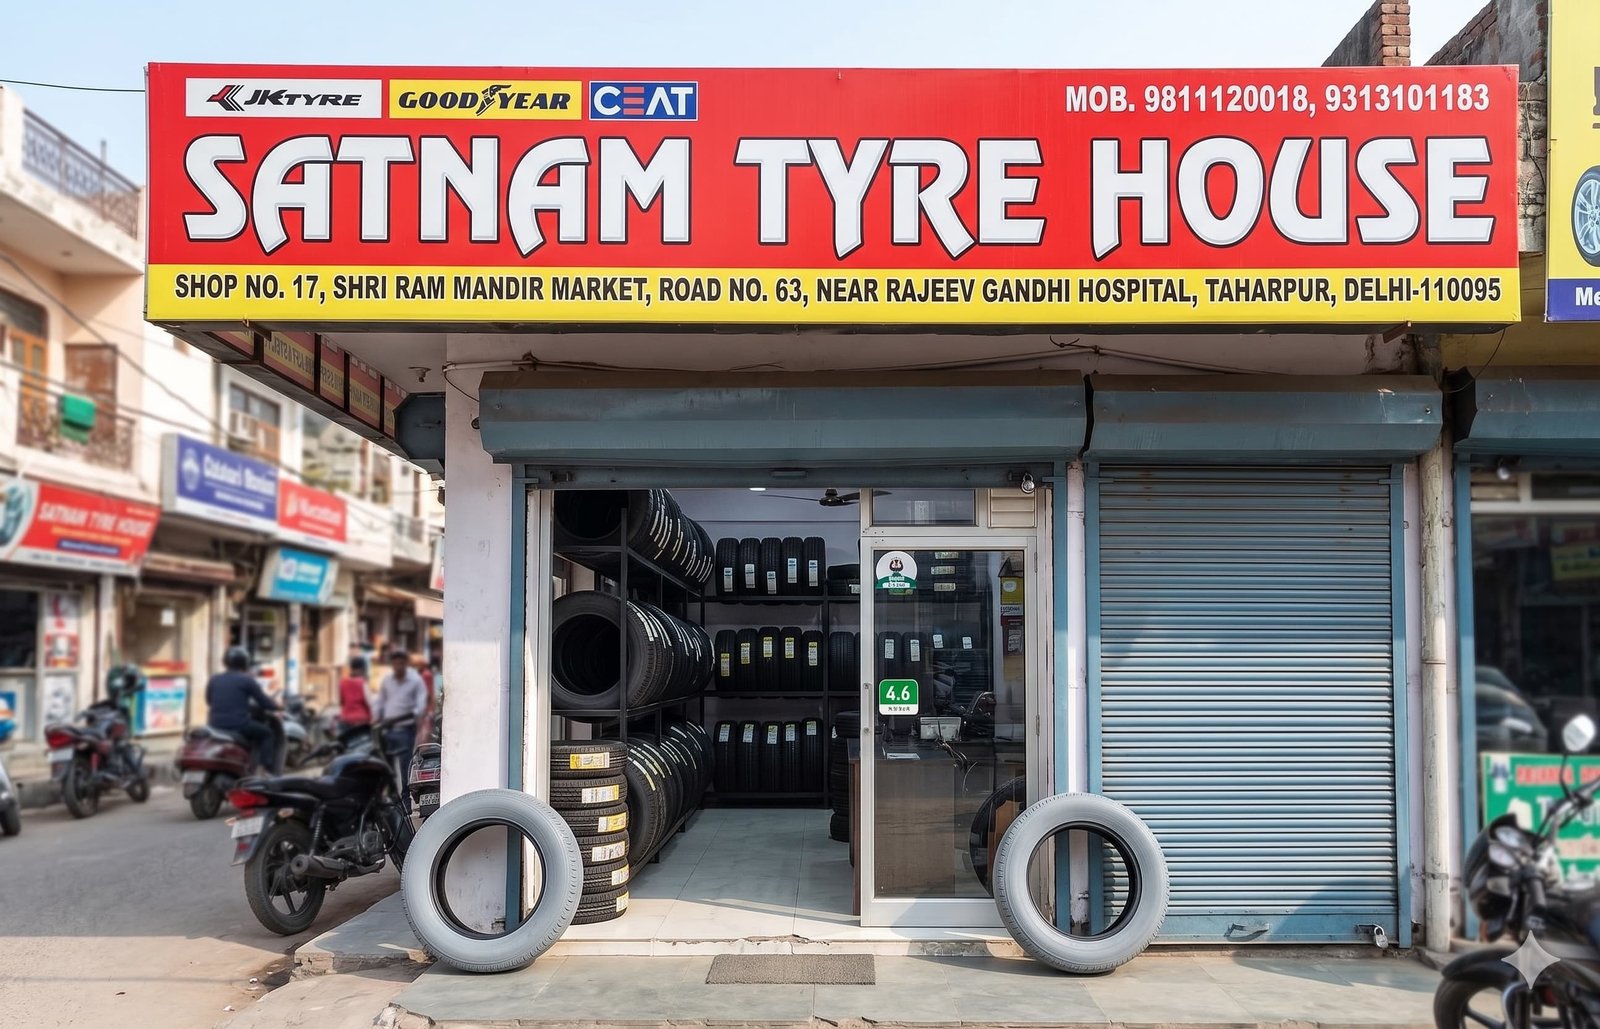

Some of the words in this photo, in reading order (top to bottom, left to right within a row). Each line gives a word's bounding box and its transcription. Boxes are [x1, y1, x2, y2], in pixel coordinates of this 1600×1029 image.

[593, 85, 694, 117] CEAT
[1066, 85, 1135, 113] MOB.
[1144, 84, 1316, 118] 9811120018,
[1325, 83, 1490, 112] 9313101183
[183, 134, 691, 258] SATNAM
[735, 137, 1047, 260] TYRE
[1091, 136, 1495, 261] HOUSE
[175, 273, 238, 299] SHOP
[246, 274, 285, 299] NO.
[293, 274, 325, 305] 17,
[333, 275, 387, 299] SHRI
[395, 275, 445, 300] RAM
[453, 276, 544, 300] MANDIR
[552, 276, 651, 307] MARKET,
[659, 277, 722, 302] ROAD
[729, 277, 768, 302] NO.
[775, 278, 808, 308] 63,
[817, 278, 879, 302] NEAR
[886, 278, 976, 303] RAJEEV
[982, 278, 1070, 303] GANDHI
[1078, 278, 1198, 308] HOSPITAL,
[1205, 278, 1336, 308] TAHARPUR,
[1344, 277, 1501, 302] DELHI-110095
[885, 685, 911, 701] 4.6
